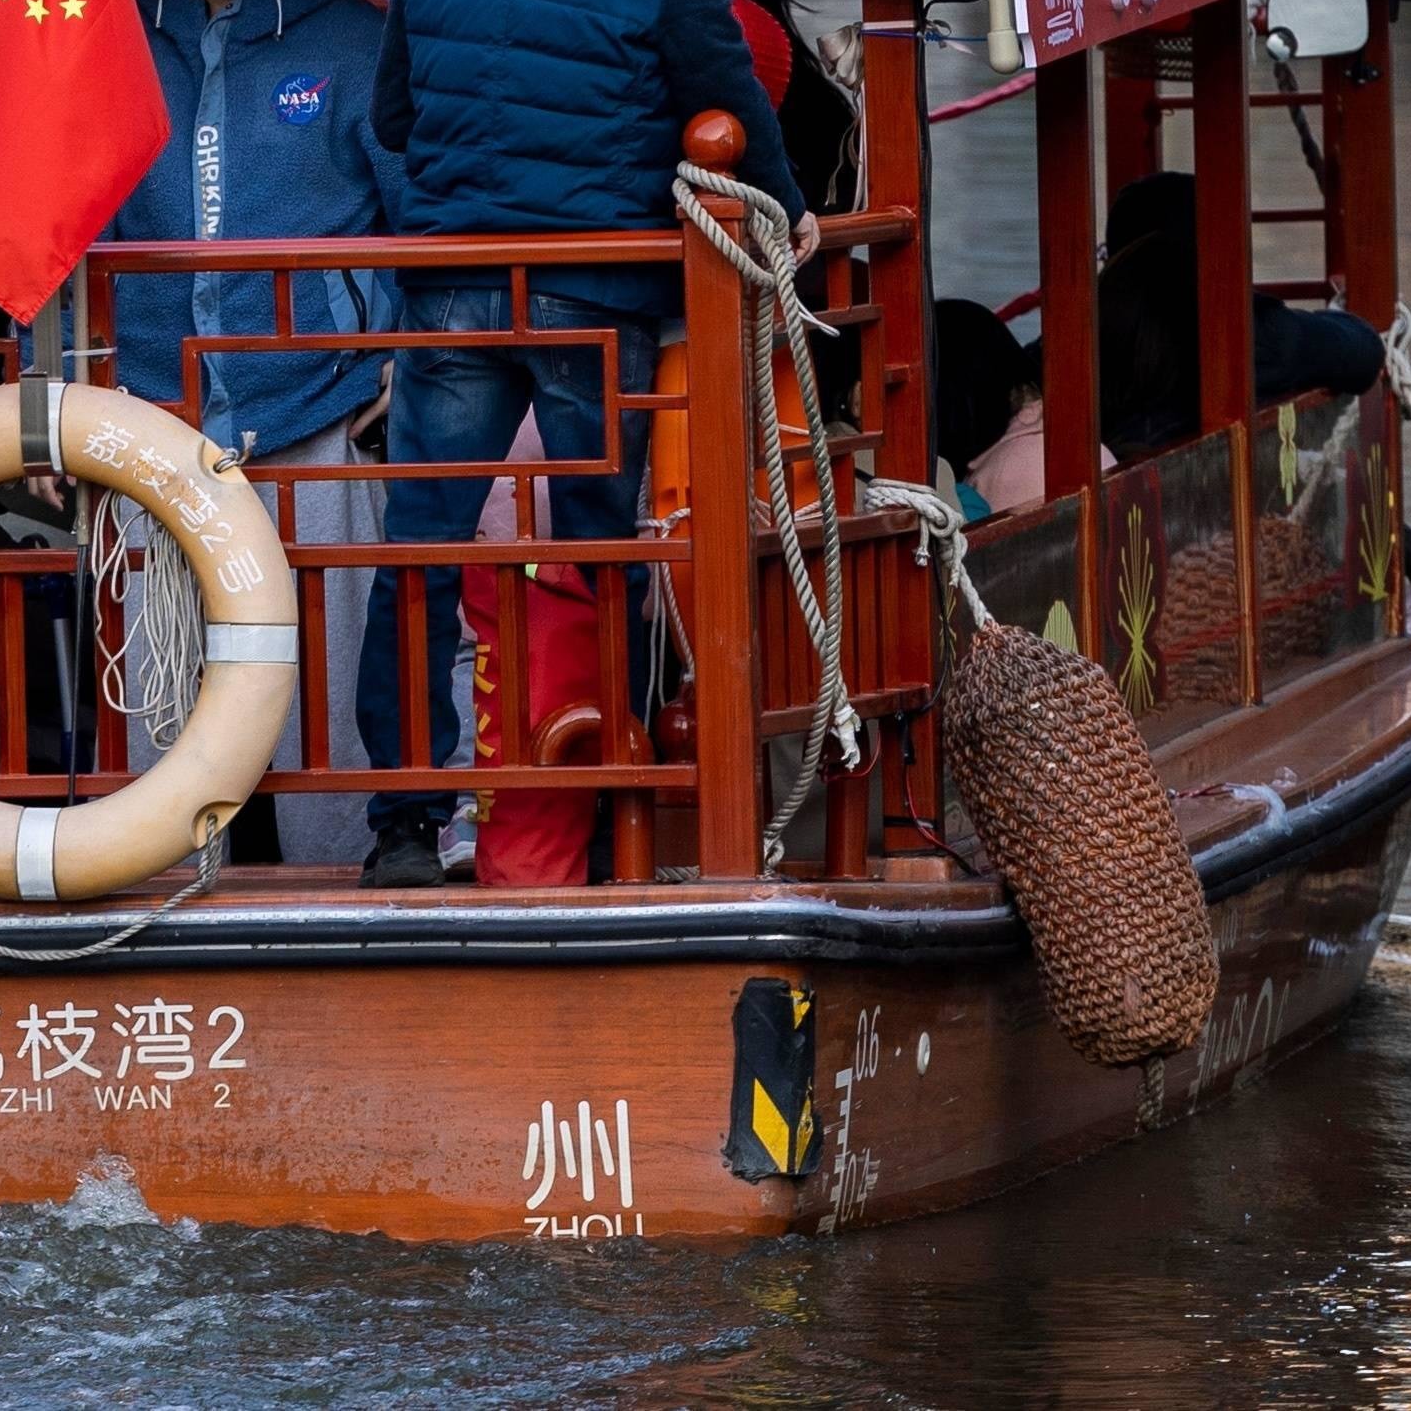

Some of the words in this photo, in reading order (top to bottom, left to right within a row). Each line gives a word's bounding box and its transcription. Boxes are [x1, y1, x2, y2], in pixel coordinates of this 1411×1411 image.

[279, 92, 320, 106] NASA
[856, 1005, 881, 1082] 0.6
[0, 1087, 53, 1113] ZHI
[94, 1084, 172, 1111] WAN
[213, 1083, 231, 1108] 2
[522, 1098, 634, 1211] 州
